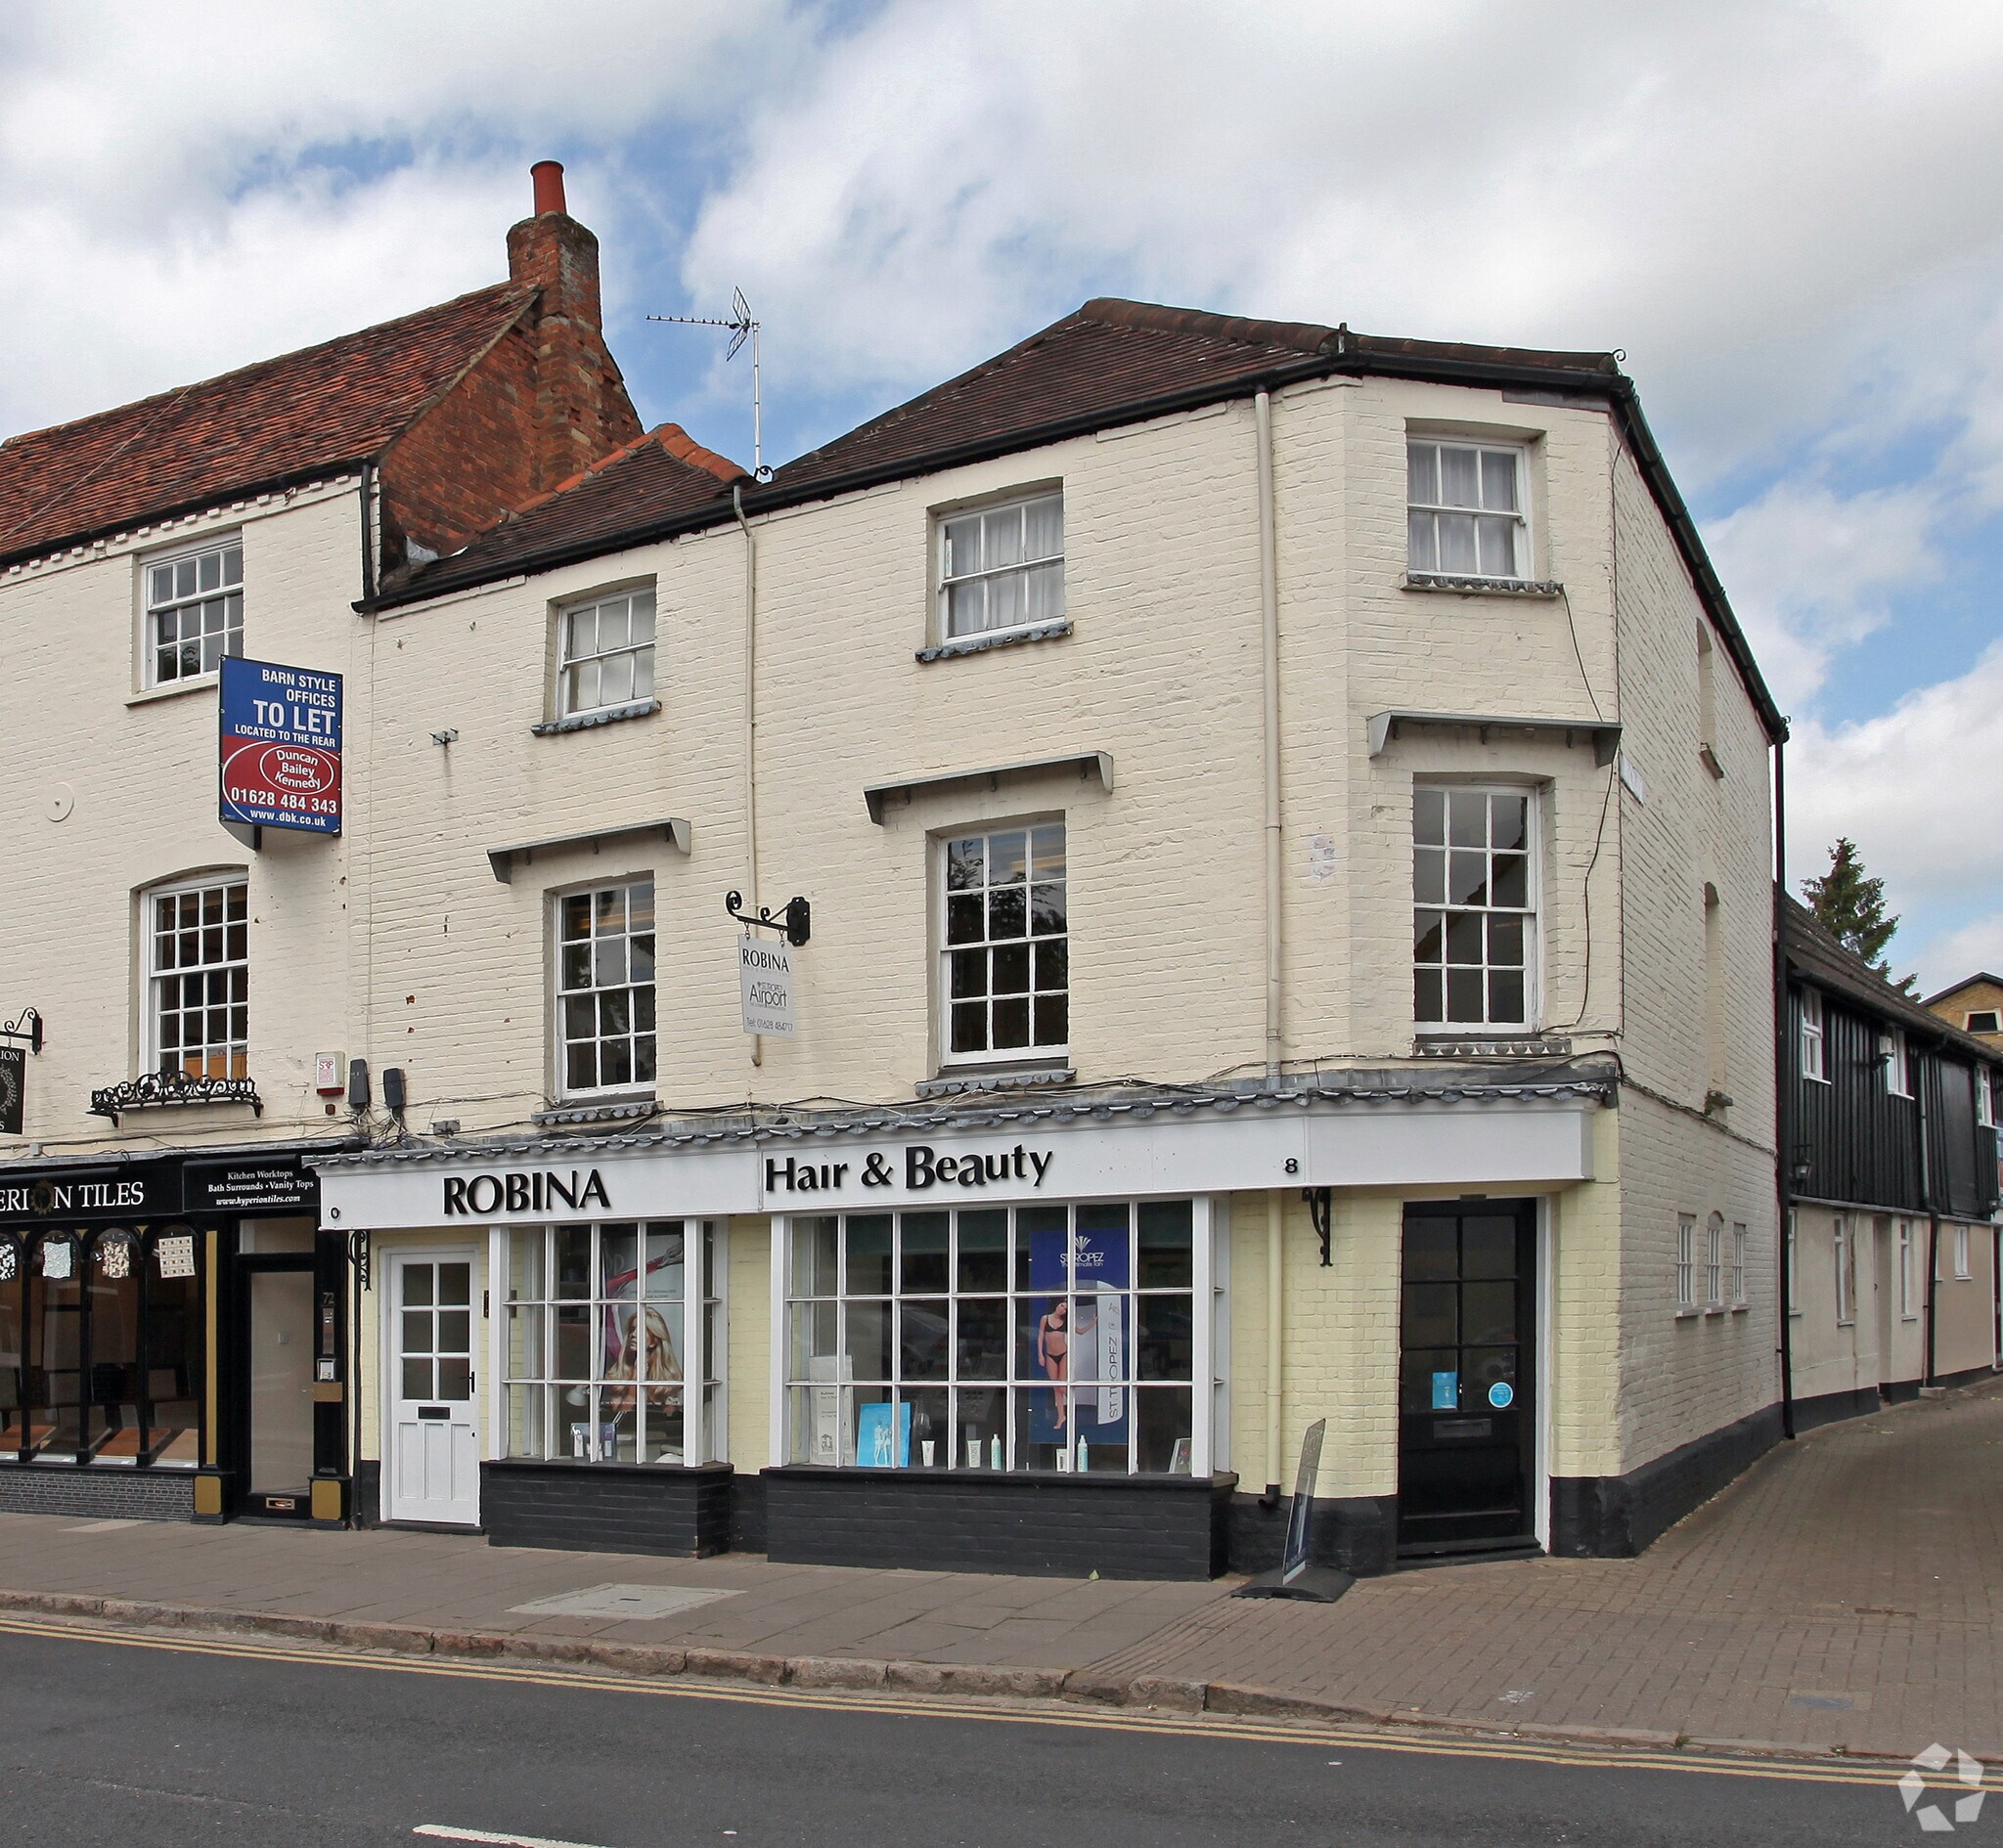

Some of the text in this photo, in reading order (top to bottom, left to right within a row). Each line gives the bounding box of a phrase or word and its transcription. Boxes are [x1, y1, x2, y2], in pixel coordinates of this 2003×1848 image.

[261, 669, 336, 692] BARN STYLE
[286, 688, 335, 708] OFFICES
[253, 699, 335, 735] TO LET
[235, 724, 335, 748] LOCATED TO THE REAR
[276, 749, 319, 767] Duncan
[274, 770, 322, 790] Kennedy
[282, 763, 316, 778] Bailey
[231, 787, 337, 814] 01628 484 343
[249, 810, 327, 827] www.dbk.co.uk
[742, 948, 789, 972] ROBINA
[749, 984, 787, 1008] Airport
[227, 1170, 293, 1180] Kitchen Worktops
[765, 1143, 1054, 1192] Hair & Beauty
[1284, 1157, 1299, 1174] 8
[78, 1181, 145, 1208] TILES
[207, 1180, 314, 1193] Bath Surrounds Vanity Tops
[442, 1168, 611, 1215] ROBINA
[215, 1195, 301, 1207] www.hyperiontiles.com
[323, 1292, 334, 1304] 72
